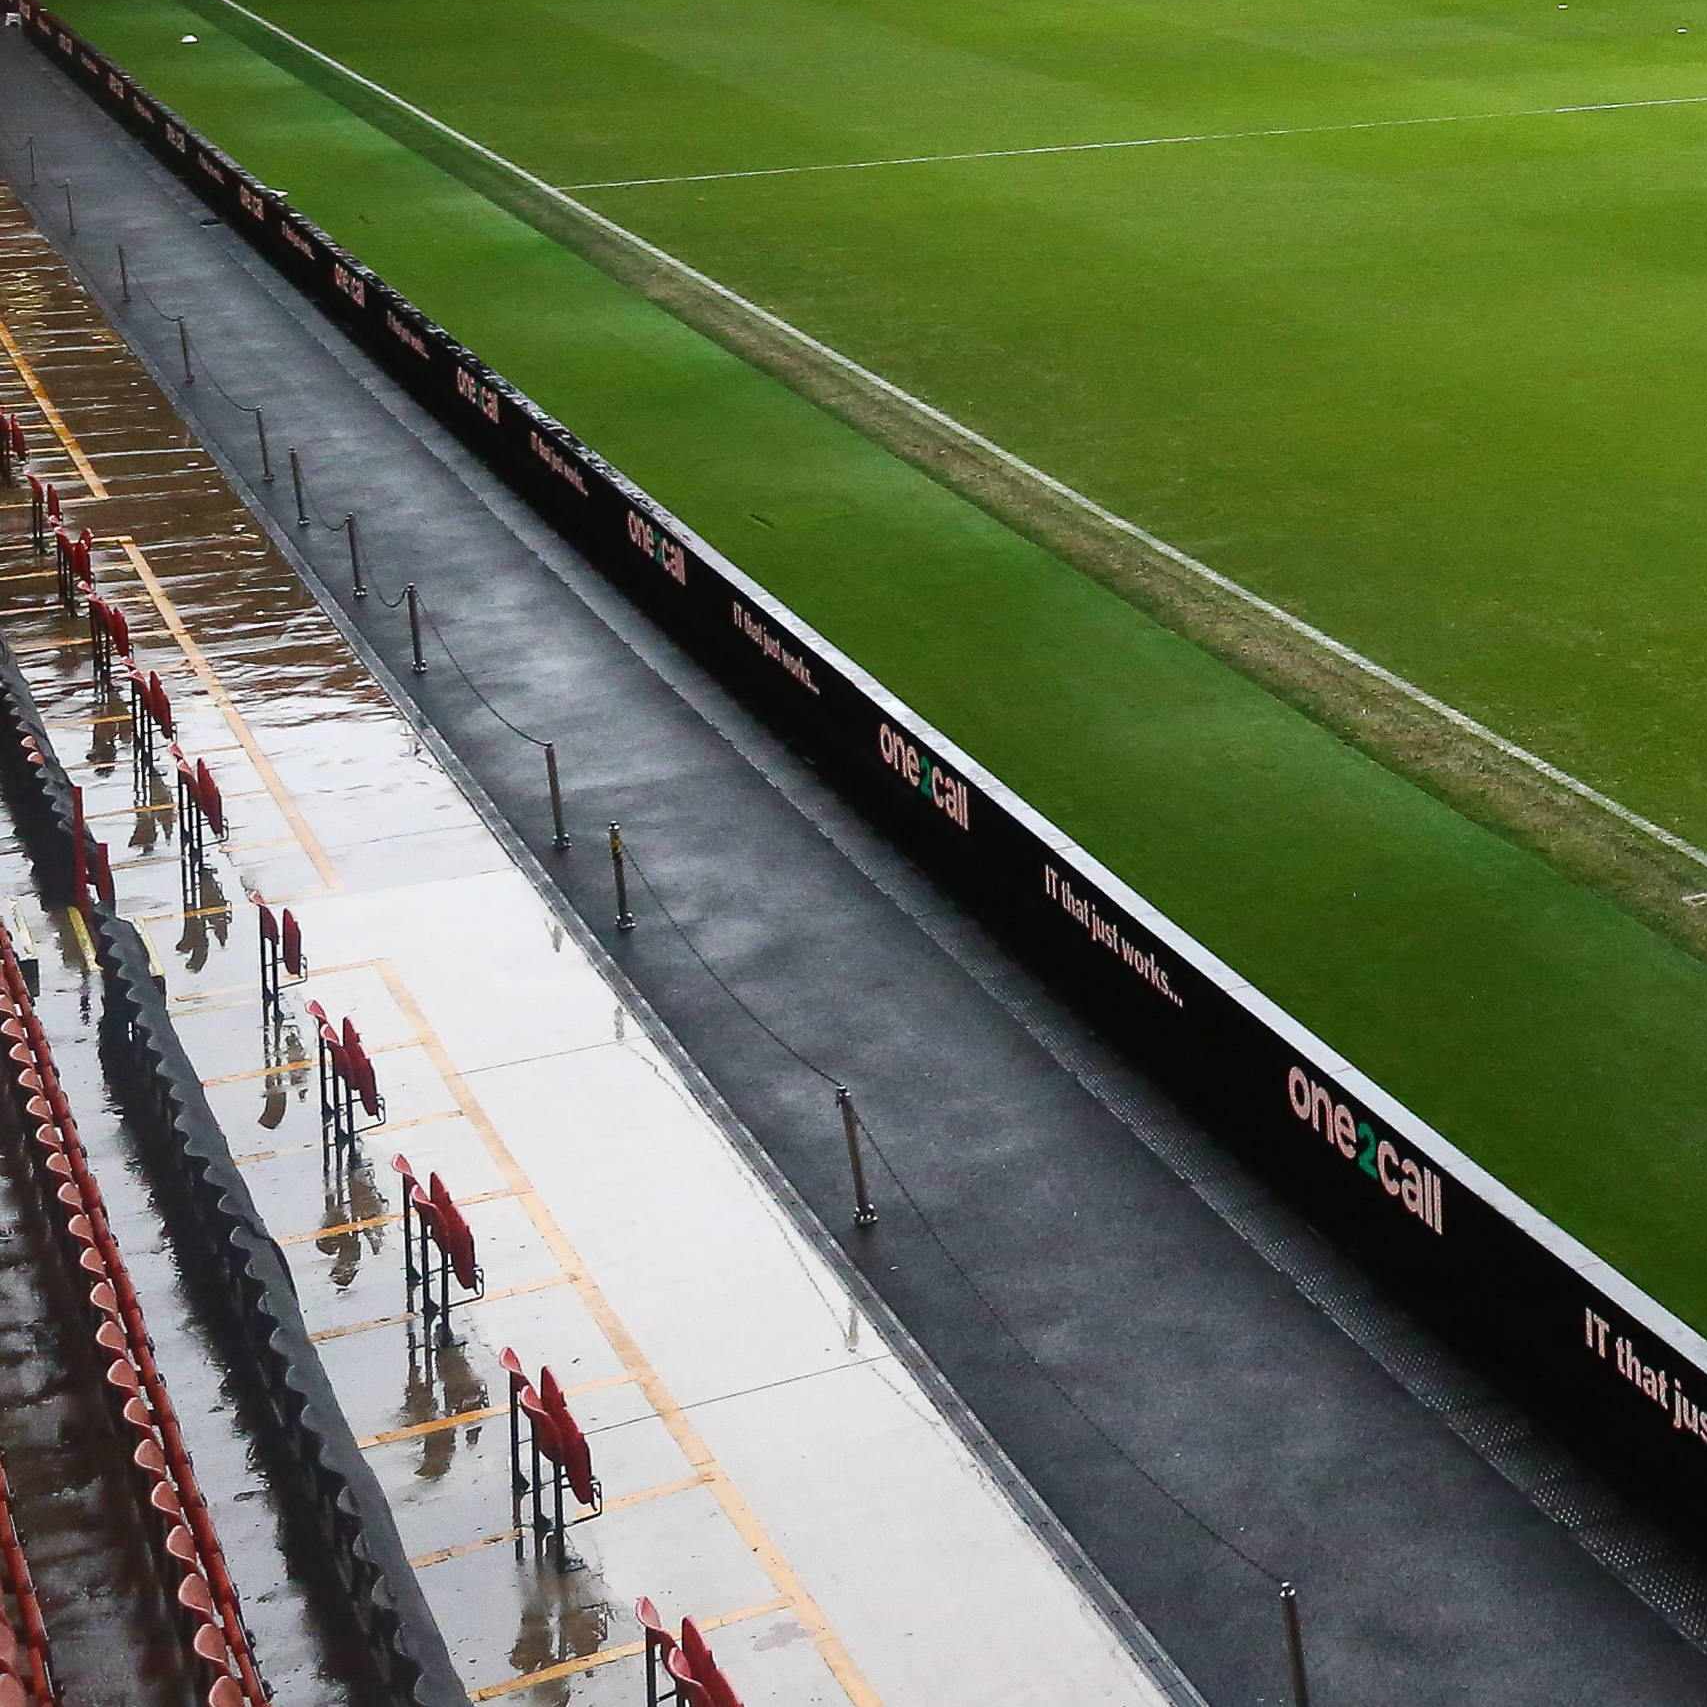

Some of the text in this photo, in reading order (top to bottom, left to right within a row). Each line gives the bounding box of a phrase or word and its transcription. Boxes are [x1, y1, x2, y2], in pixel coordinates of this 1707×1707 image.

[627, 509, 687, 586] one2call
[878, 722, 969, 832] one2call
[1045, 864, 1183, 1008] IT that just works...
[1287, 1064, 1443, 1236] one2call
[1585, 1306, 1612, 1359] IT
[1615, 1334, 1670, 1409] that
